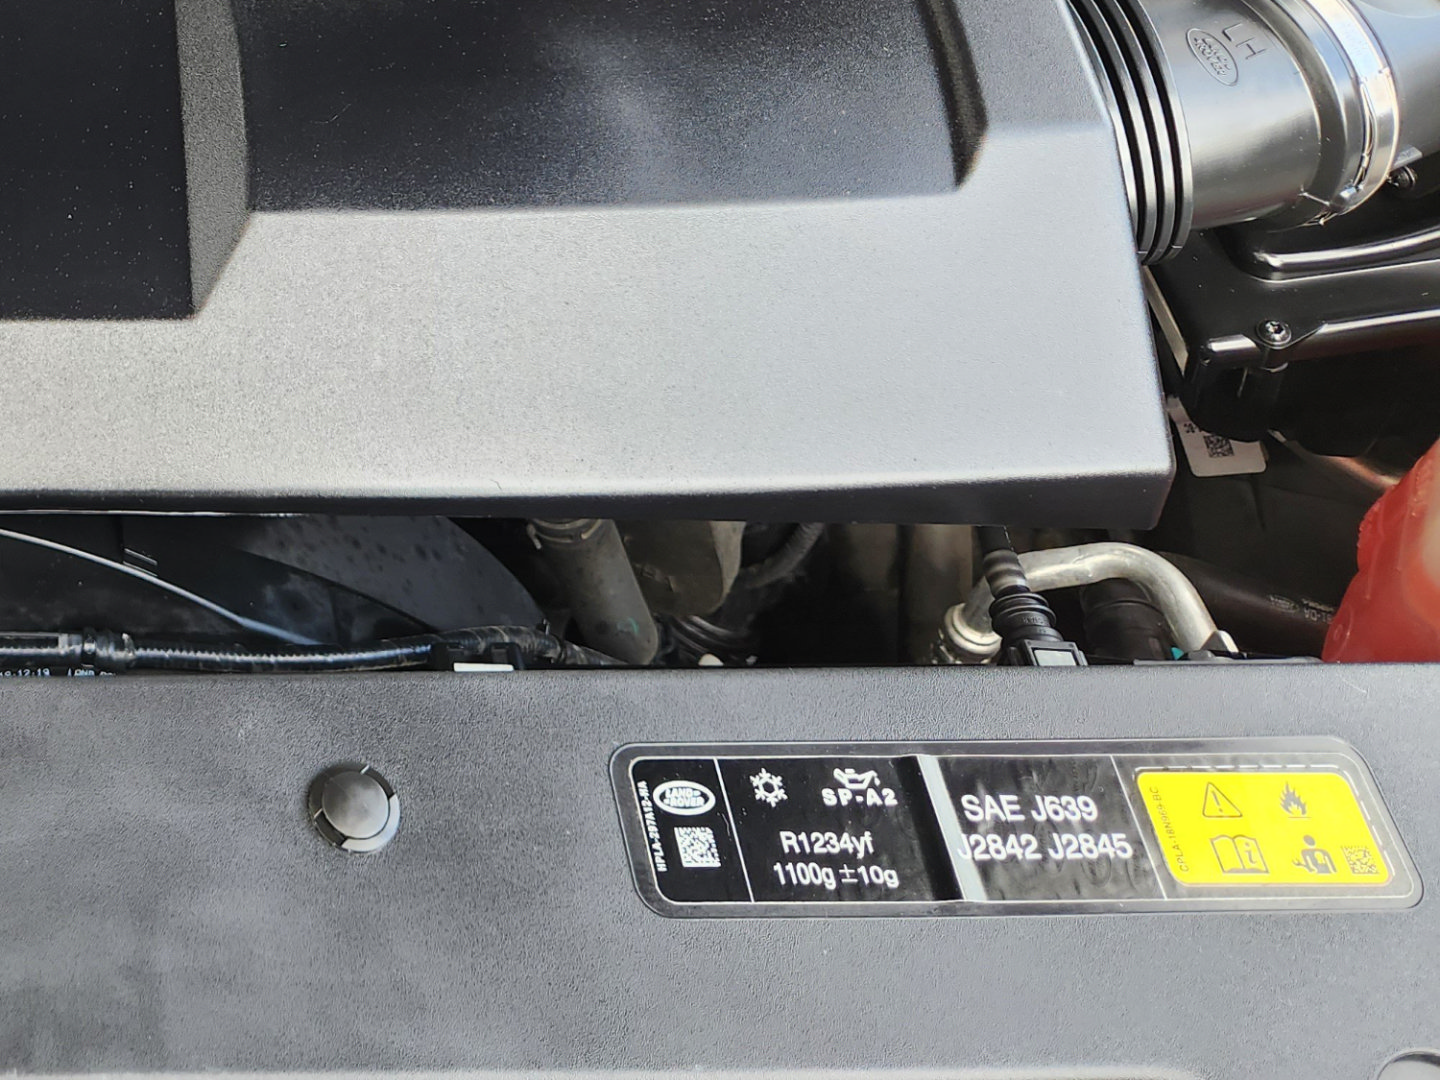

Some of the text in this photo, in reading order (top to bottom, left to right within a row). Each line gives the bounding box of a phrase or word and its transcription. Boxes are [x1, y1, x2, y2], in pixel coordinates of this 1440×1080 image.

[1222, 23, 1267, 60] LH
[664, 786, 694, 799] LAND
[669, 796, 706, 808] ROVER
[821, 788, 898, 807] SP-A2
[961, 794, 1098, 822] SAE J639
[779, 831, 875, 860] R1234yf
[957, 832, 1133, 861] J2842 J2845
[773, 862, 837, 890] 1100g
